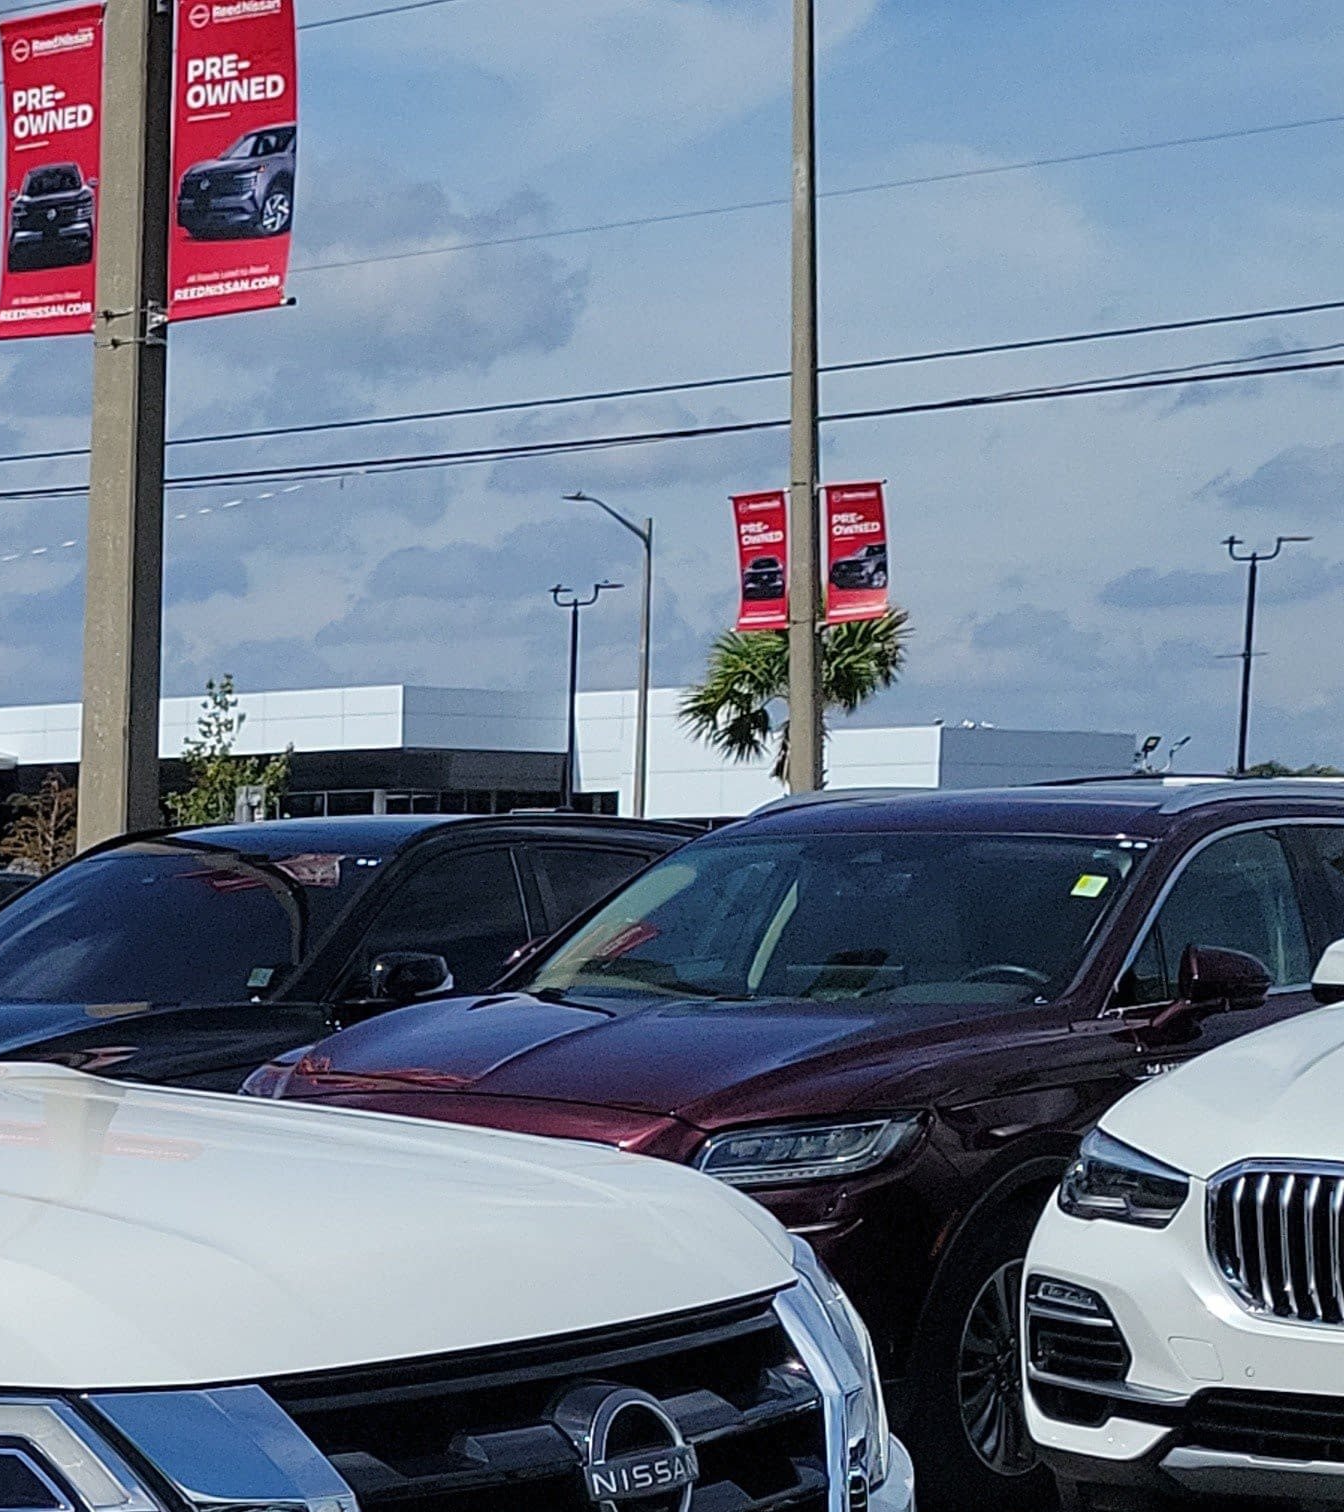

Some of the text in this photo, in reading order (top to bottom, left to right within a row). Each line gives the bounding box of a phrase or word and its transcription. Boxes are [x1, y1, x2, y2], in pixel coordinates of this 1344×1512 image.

[187, 53, 251, 82] PRE-
[13, 84, 66, 113] PRE-
[186, 74, 285, 109] OWNED
[13, 104, 93, 138] OWNED
[174, 275, 280, 301] REEDNISSAN.COM
[591, 1453, 698, 1495] NISSAN
